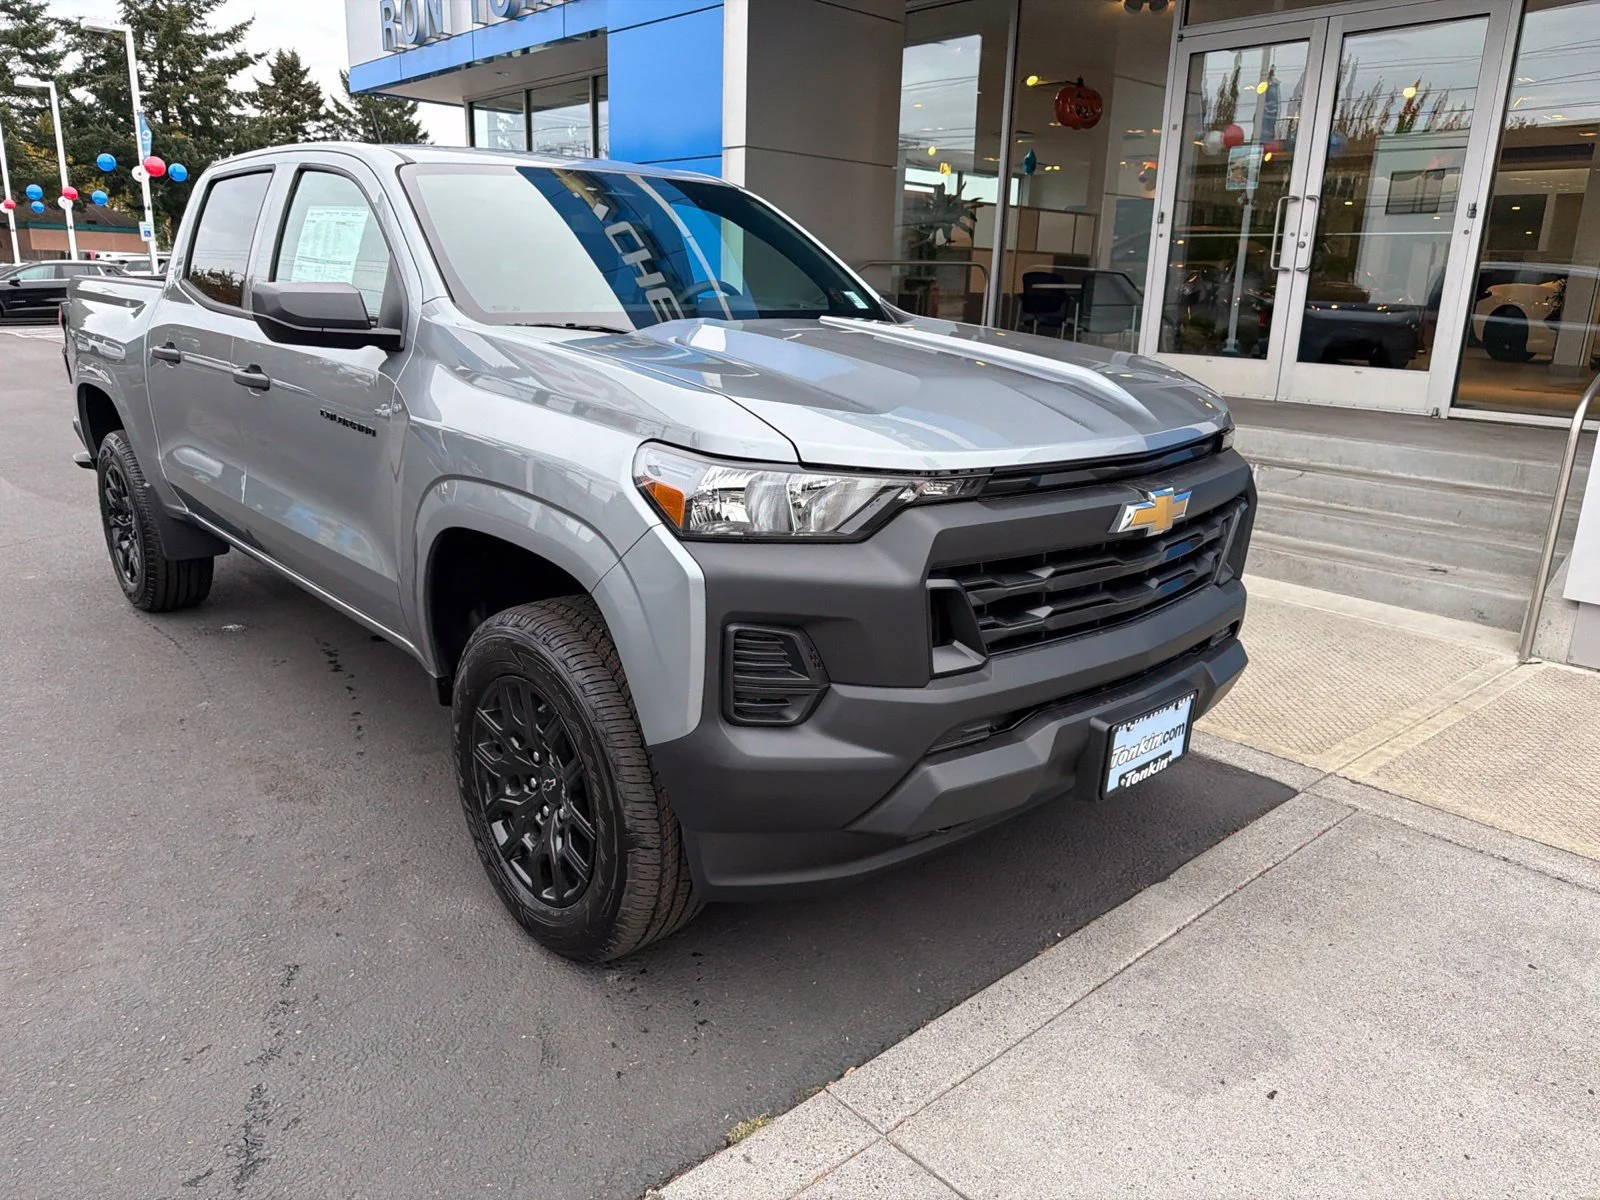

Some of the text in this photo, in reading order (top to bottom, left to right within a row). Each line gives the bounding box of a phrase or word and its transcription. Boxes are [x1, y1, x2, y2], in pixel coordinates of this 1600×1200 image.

[380, 0, 448, 52] RON
[1109, 722, 1186, 769] Tonkin.com
[1125, 757, 1169, 788] Tonkin
